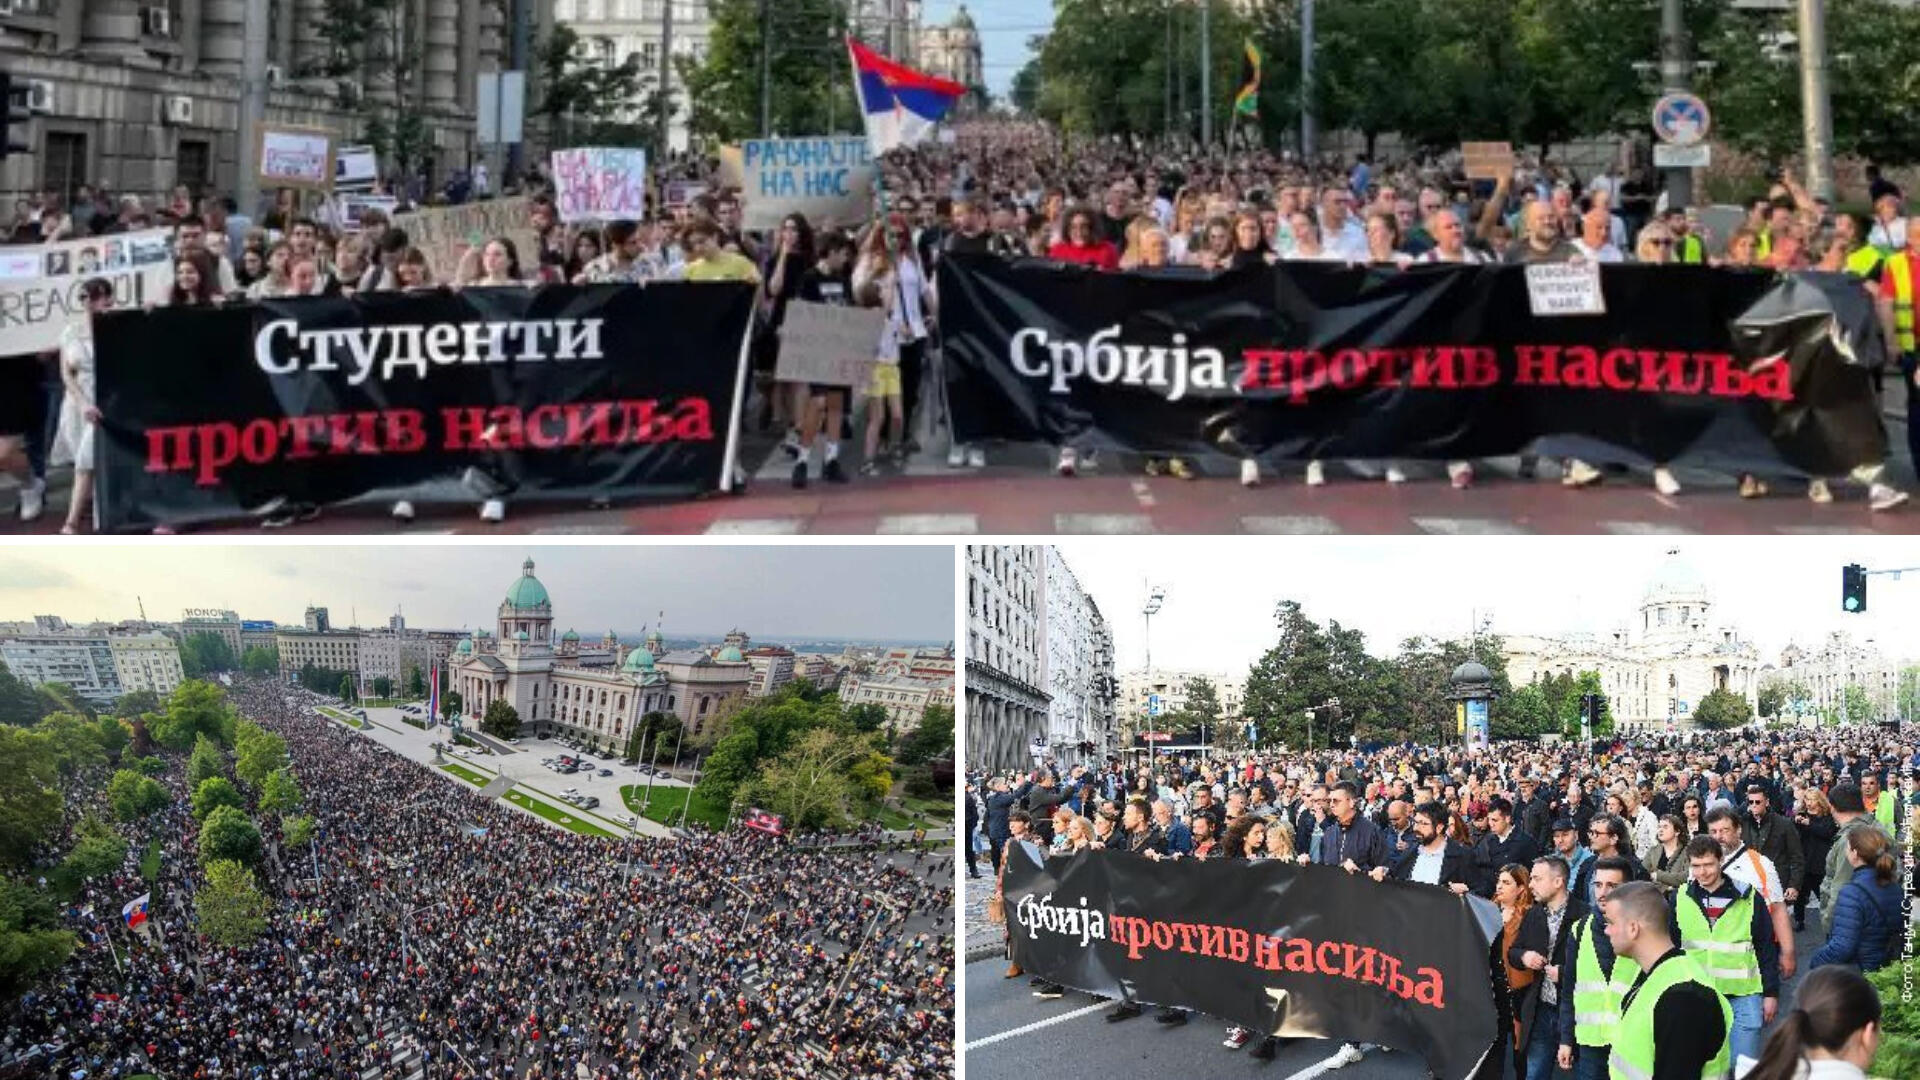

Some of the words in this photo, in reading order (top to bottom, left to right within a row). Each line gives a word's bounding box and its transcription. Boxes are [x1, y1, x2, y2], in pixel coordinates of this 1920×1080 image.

[761, 171, 796, 197] НА
[804, 169, 850, 197] НАС
[254, 318, 605, 385] Студенти
[1009, 324, 1227, 401] Србија
[1240, 344, 1499, 403] против
[1513, 343, 1794, 400] насиља
[144, 406, 427, 484] против
[442, 395, 714, 452] насиља
[185, 608, 224, 617] HONOR
[1016, 892, 1106, 947] Србија
[1109, 913, 1251, 959] против
[1254, 935, 1446, 1009] насиља
